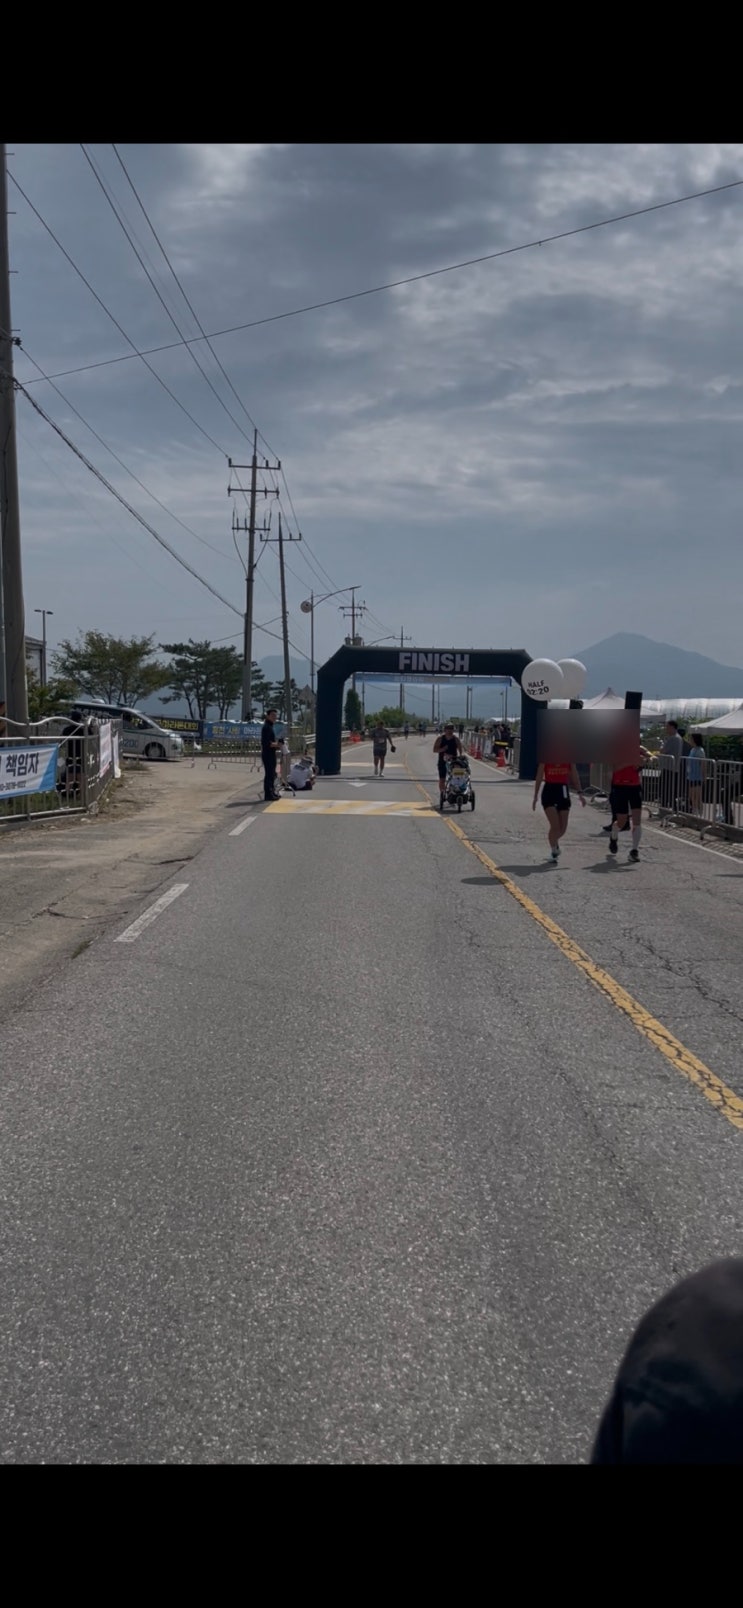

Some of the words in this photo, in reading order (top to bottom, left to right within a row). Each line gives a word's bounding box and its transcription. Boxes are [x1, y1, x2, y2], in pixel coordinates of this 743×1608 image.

[399, 653, 470, 672] FINISH
[527, 679, 545, 688] HALF
[5, 752, 40, 777] 책임자
